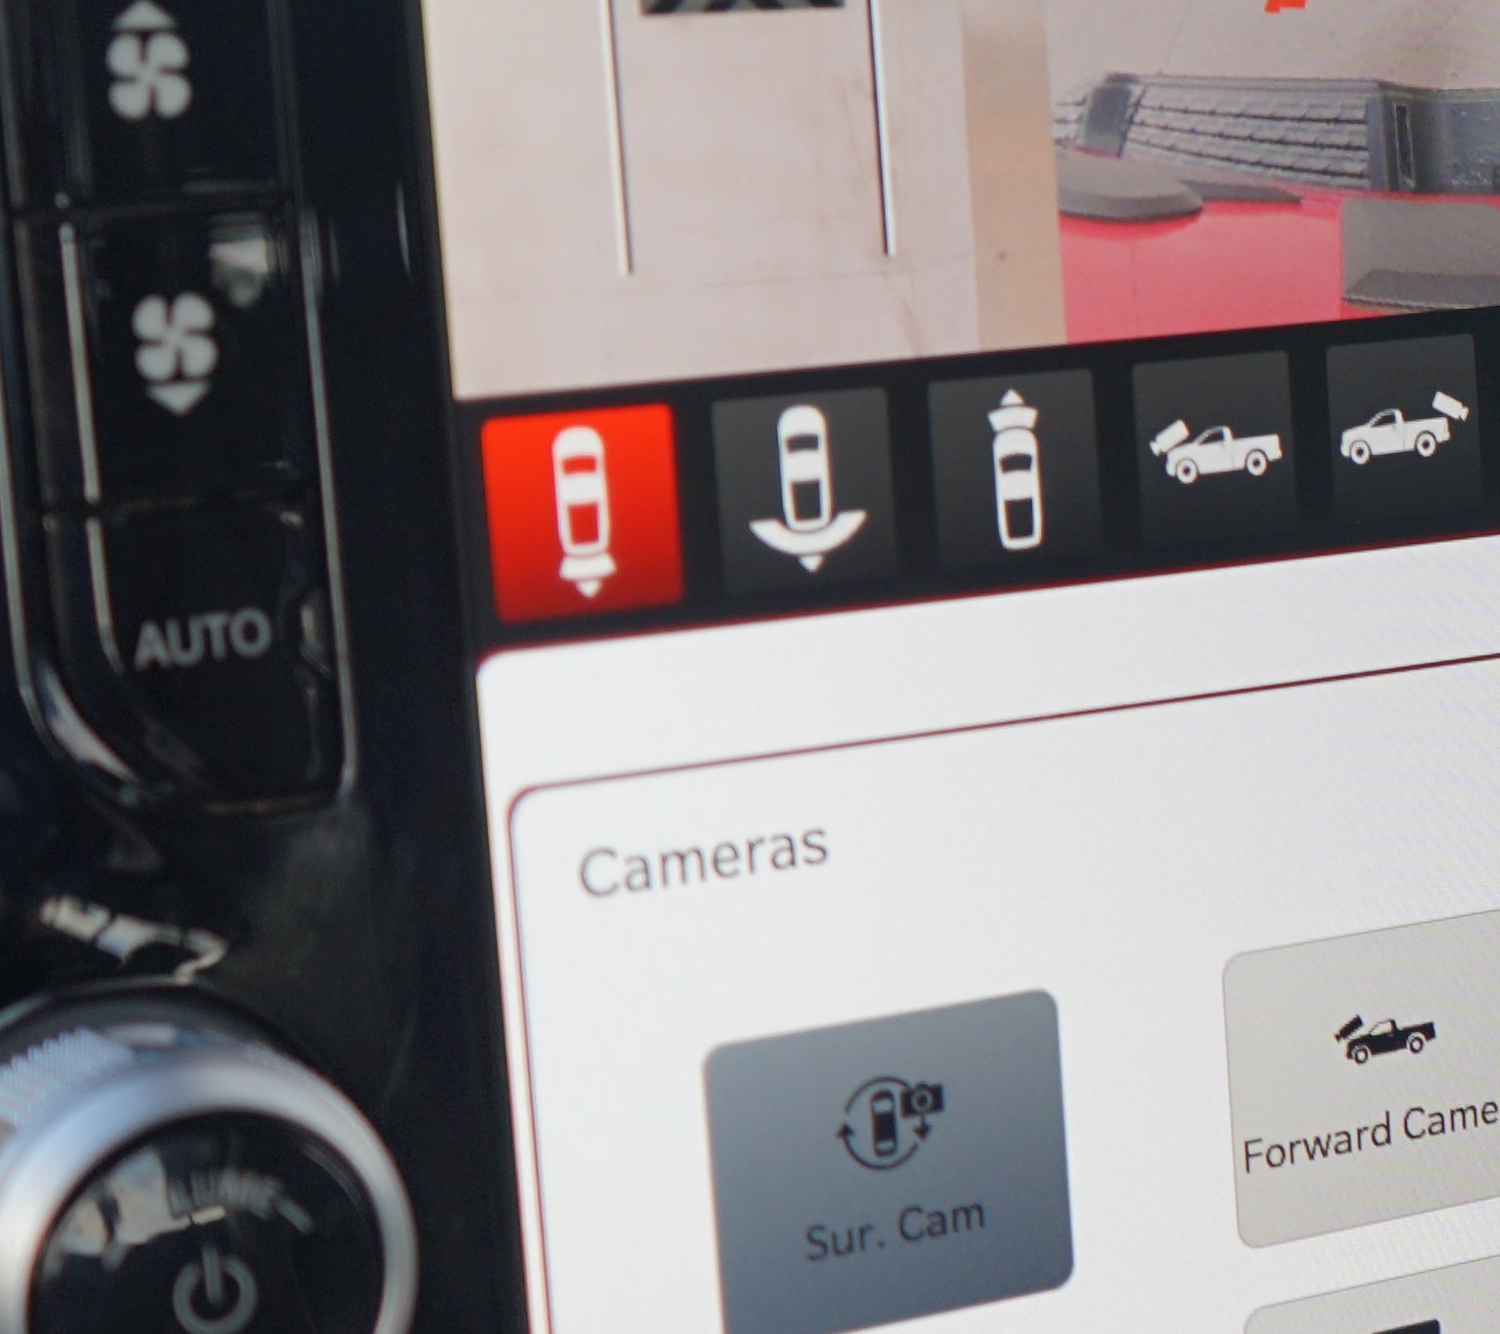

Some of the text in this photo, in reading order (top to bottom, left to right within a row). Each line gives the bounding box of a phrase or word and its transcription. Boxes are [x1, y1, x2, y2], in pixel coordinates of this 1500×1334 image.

[134, 606, 271, 670] AUTO
[578, 827, 829, 898] Cameras
[1243, 1112, 1394, 1173] Forward
[804, 1200, 987, 1262] Sur. Cam
